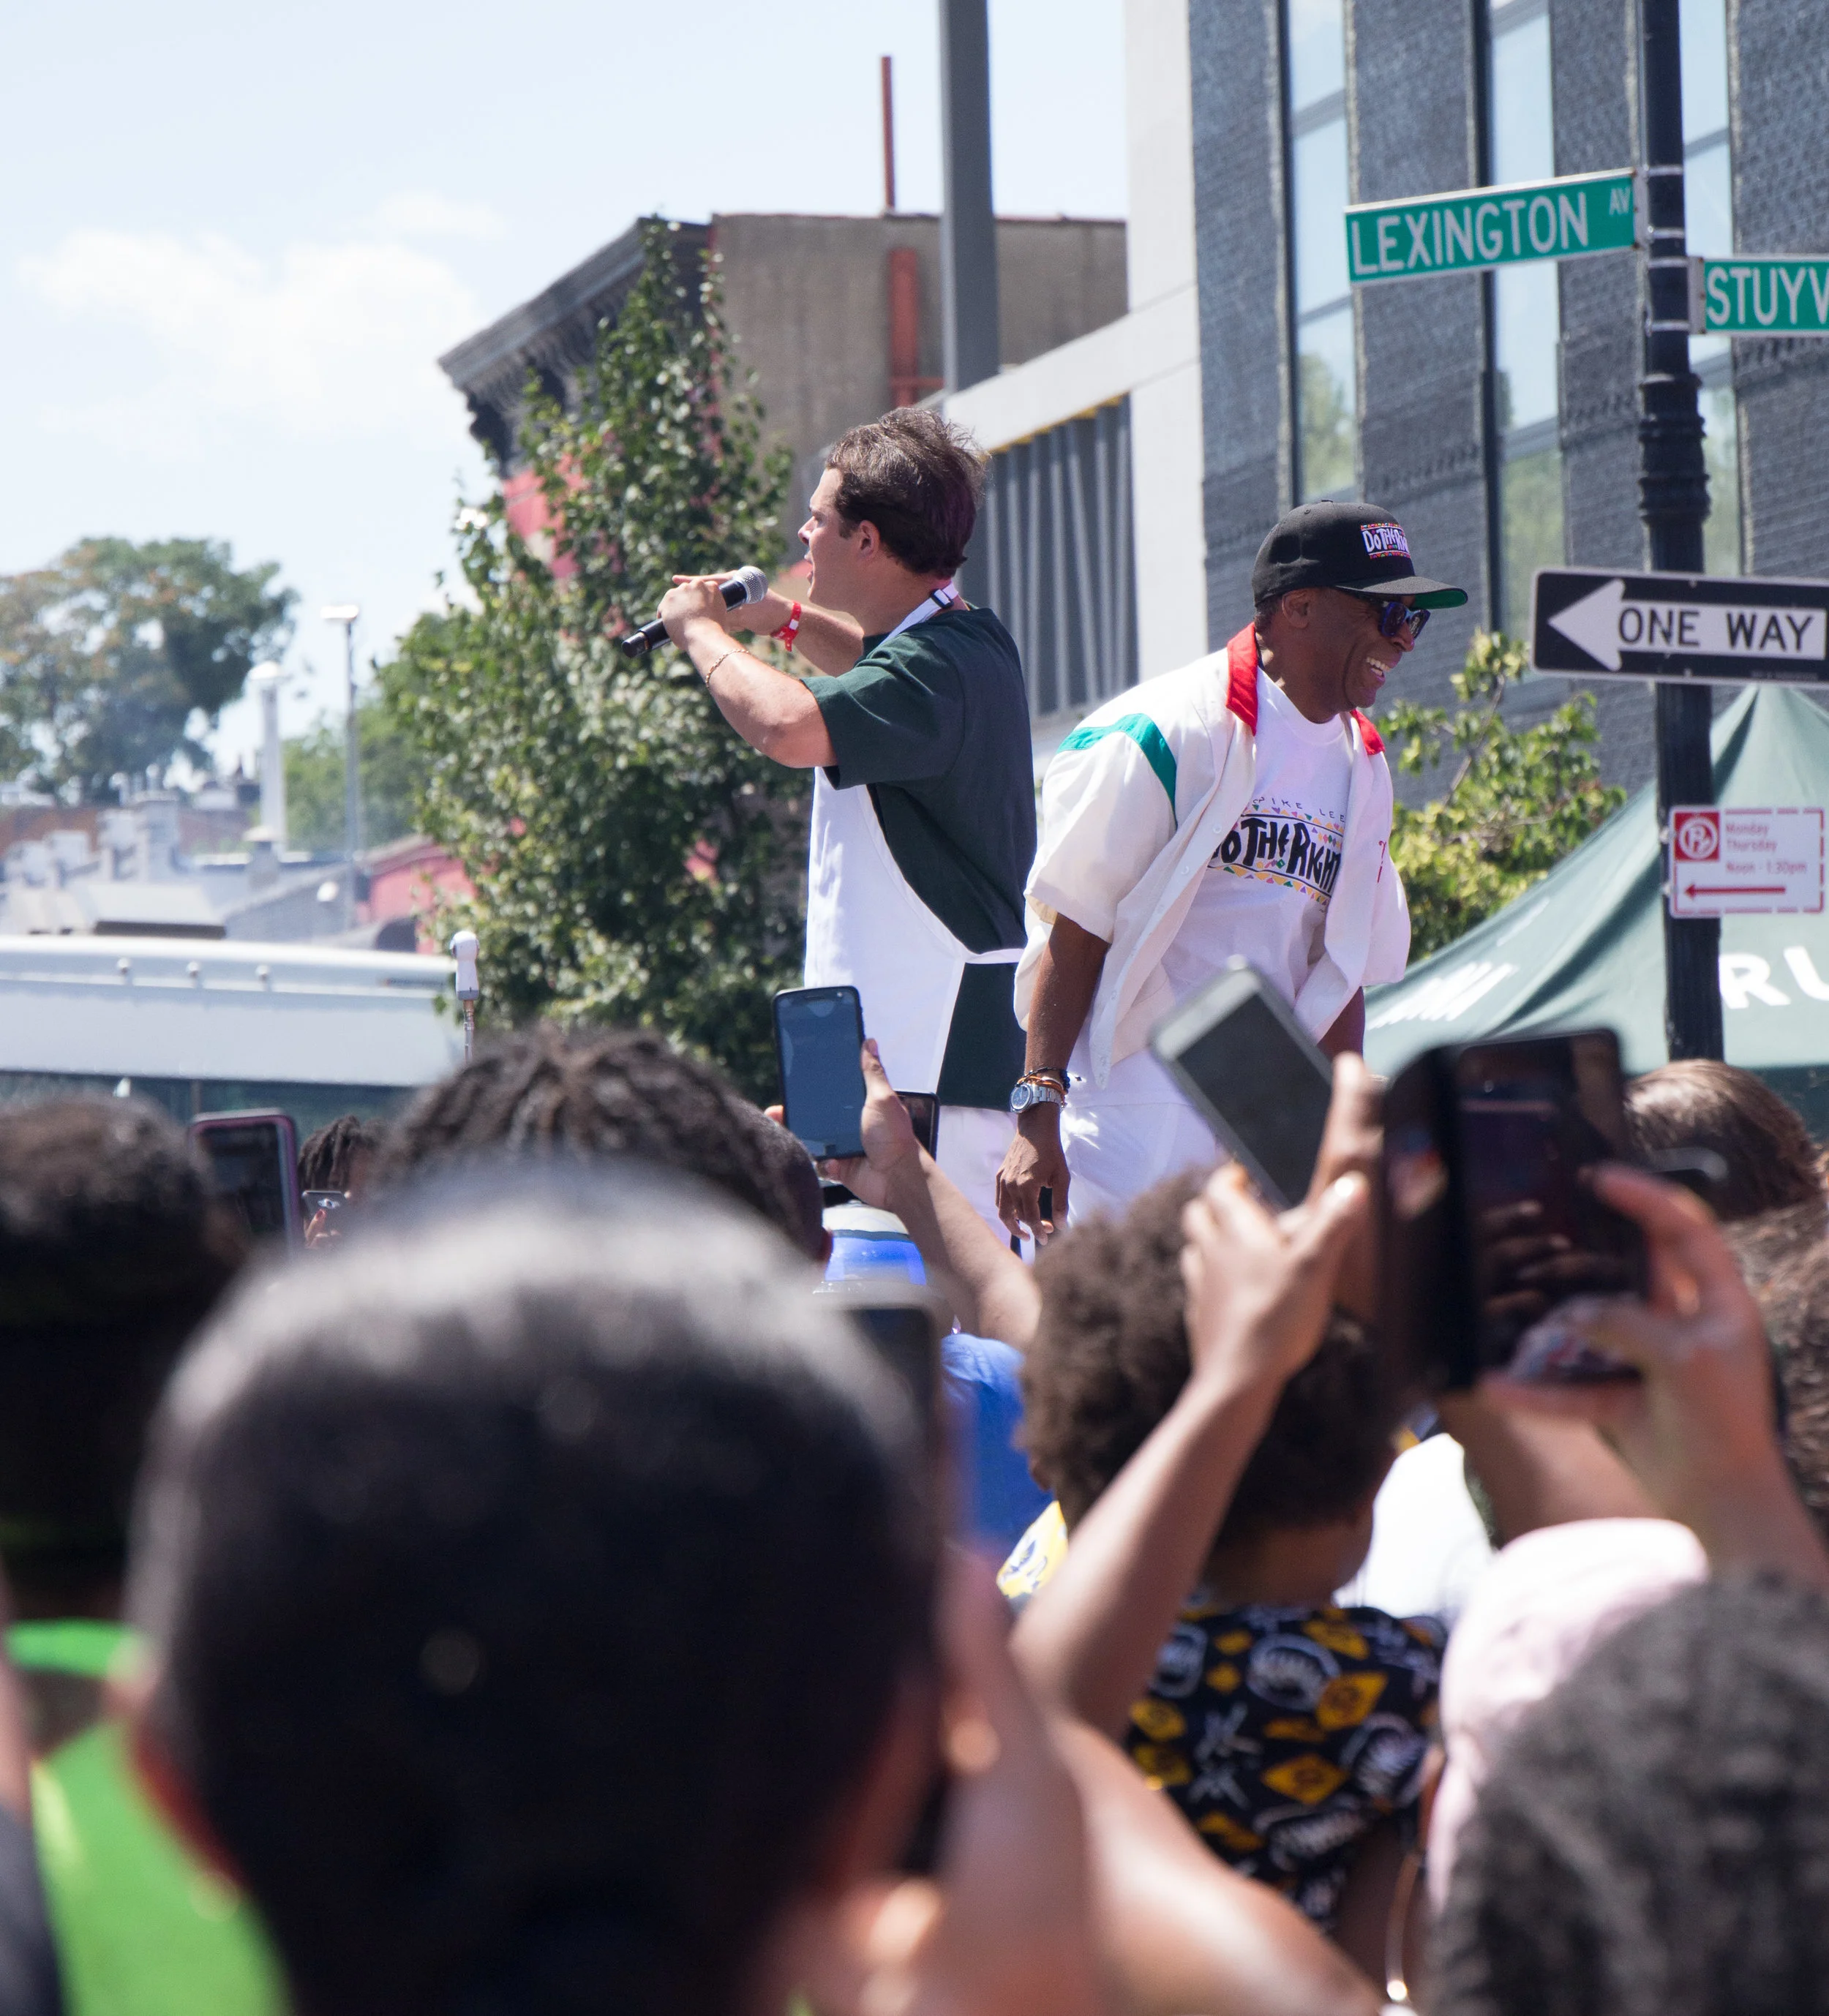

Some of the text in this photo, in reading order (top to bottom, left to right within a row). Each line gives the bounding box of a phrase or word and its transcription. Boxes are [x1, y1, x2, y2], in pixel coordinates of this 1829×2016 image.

[1351, 187, 1631, 275] LEXINGTON AV
[1707, 266, 1829, 326] STUYV
[1618, 608, 1814, 652] ONE WAY
[1726, 824, 1768, 837] Monday
